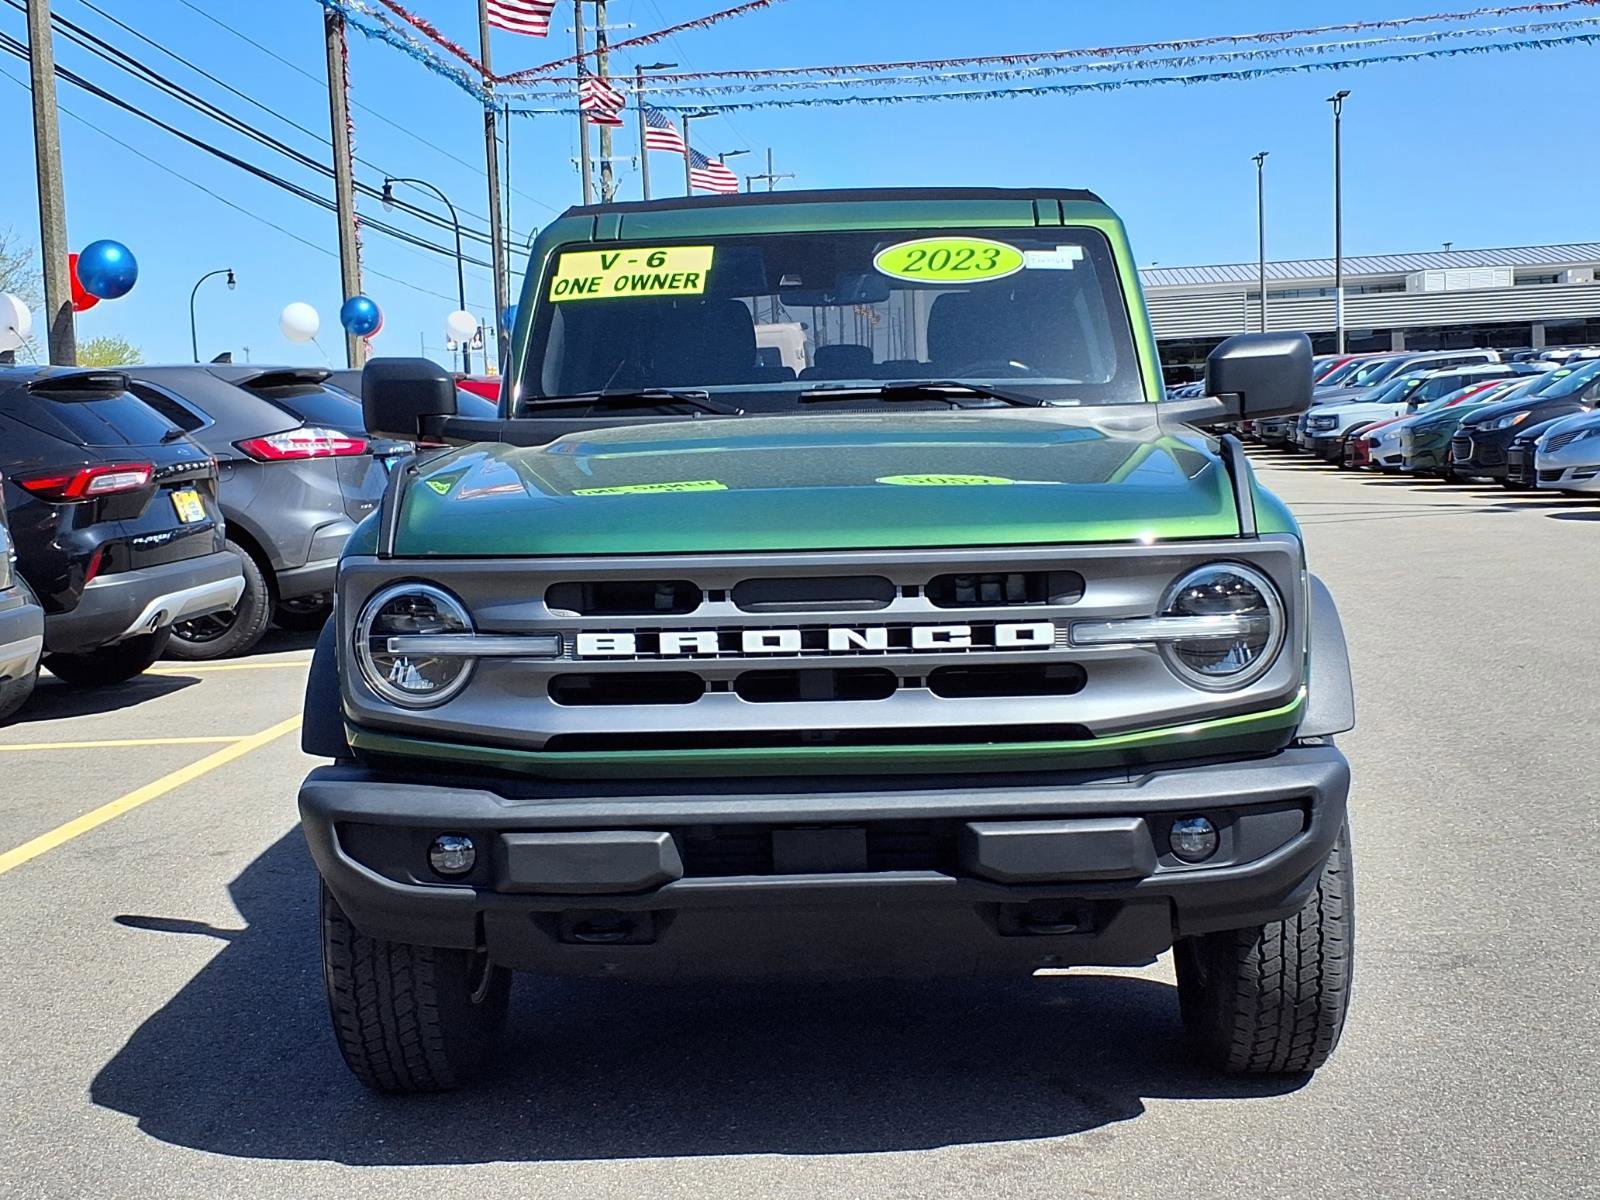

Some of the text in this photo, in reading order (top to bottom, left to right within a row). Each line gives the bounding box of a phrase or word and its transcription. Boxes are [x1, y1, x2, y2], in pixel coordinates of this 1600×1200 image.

[901, 248, 1001, 272] 2023
[554, 272, 700, 296] ONE OWNER
[576, 621, 1056, 656] BRONCO
